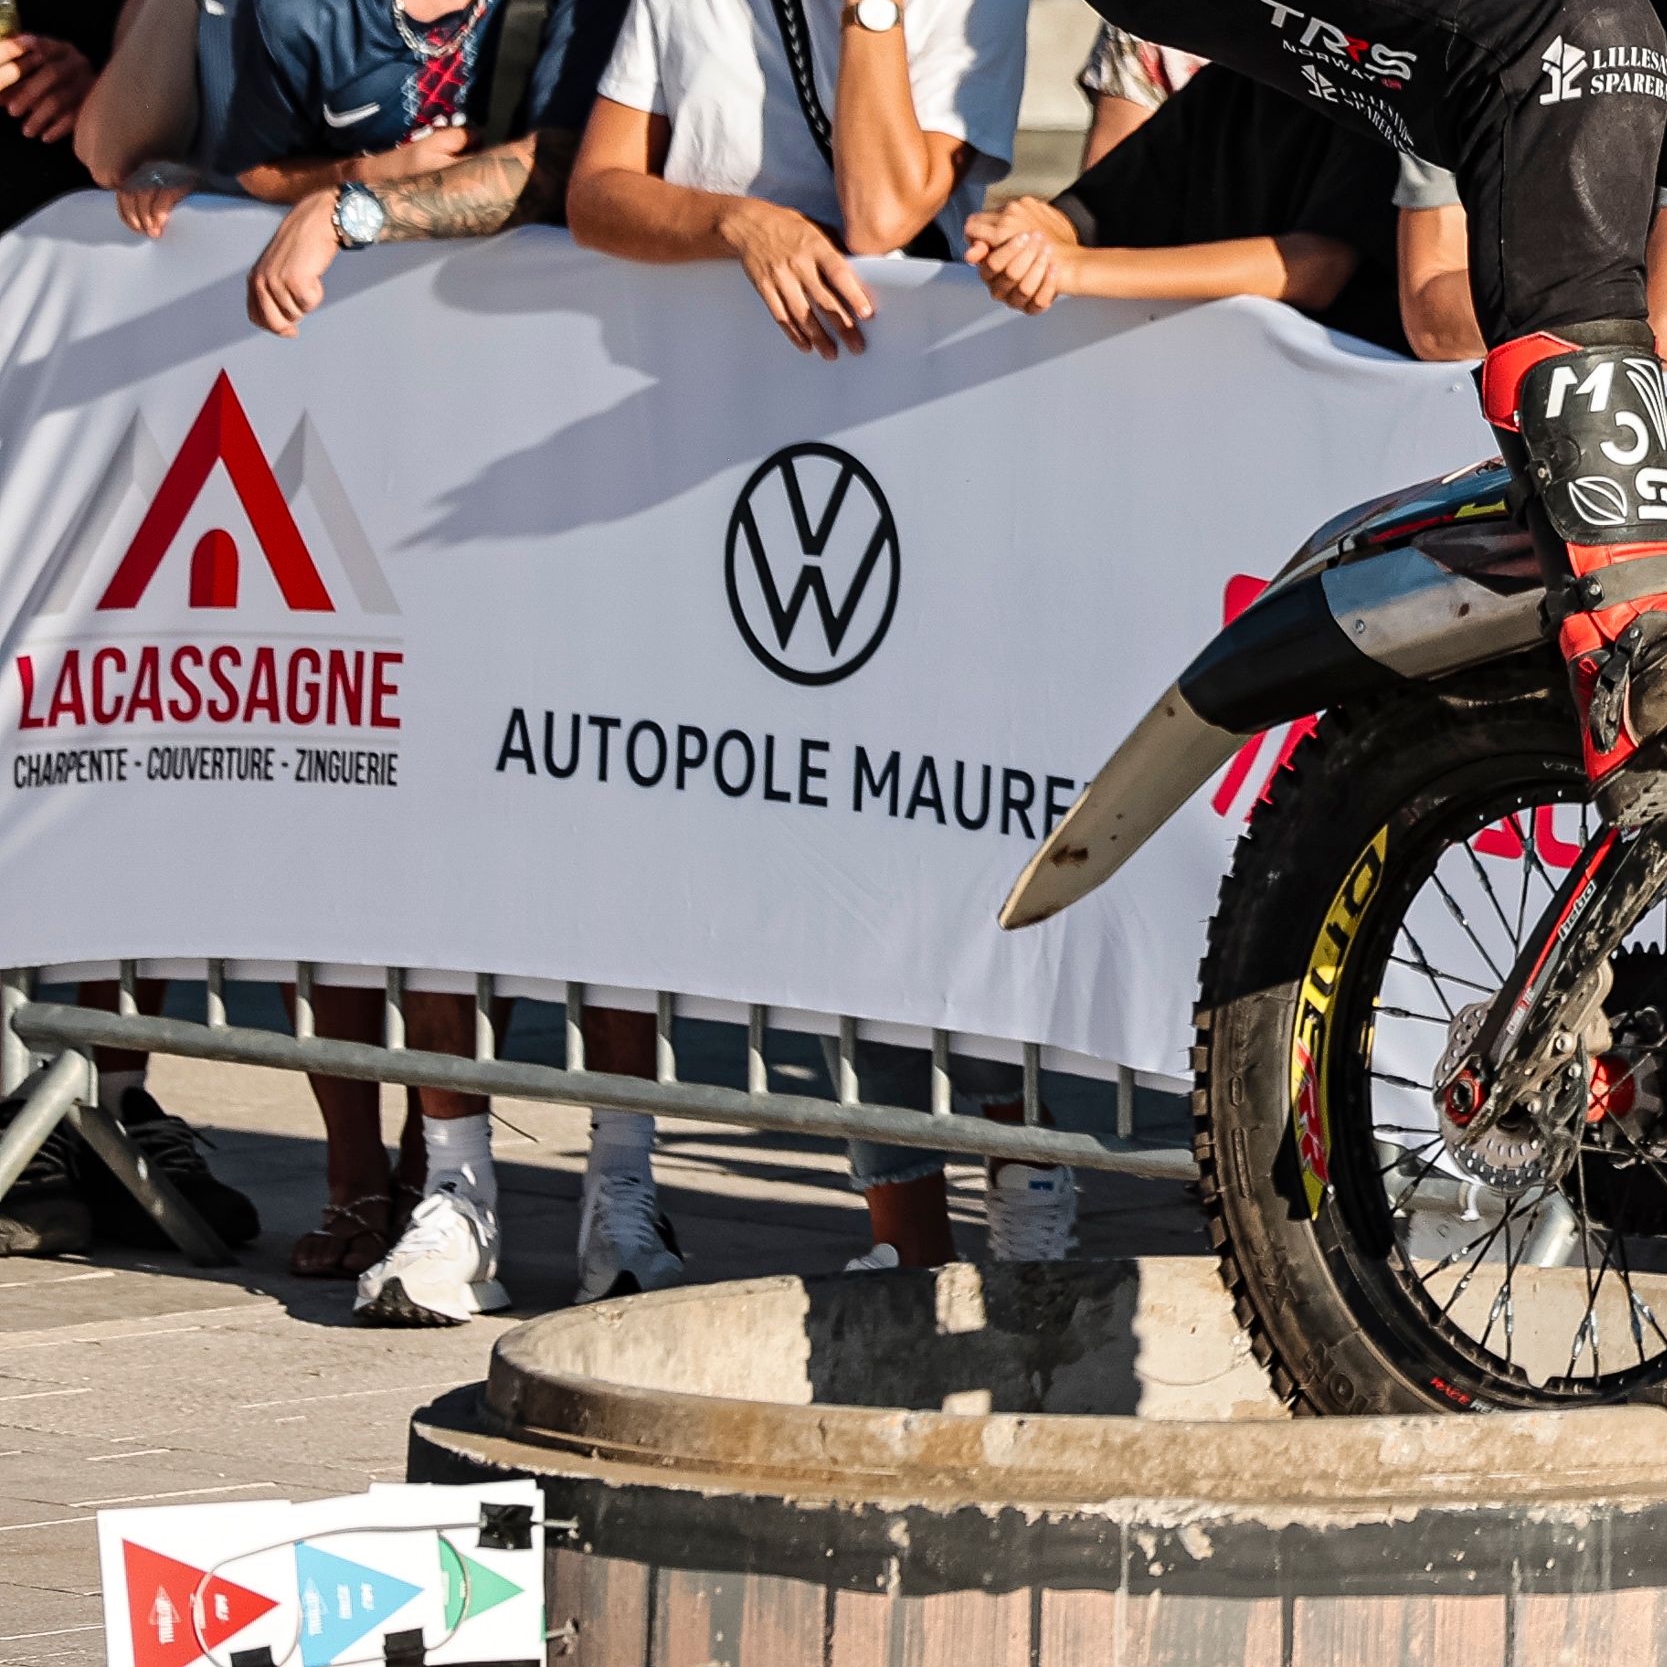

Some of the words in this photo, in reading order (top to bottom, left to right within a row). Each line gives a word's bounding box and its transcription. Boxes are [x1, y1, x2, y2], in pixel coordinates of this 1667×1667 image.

[1282, 39, 1376, 82] NORWAY
[16, 645, 403, 730] LACASSAGNE
[13, 747, 128, 789] CHARPENTE
[146, 745, 275, 782] COUVERTURE
[294, 750, 399, 788] ZINGUERIE
[496, 707, 830, 809] AUTOPOLE
[851, 745, 1078, 840] MAURE
[1558, 881, 1597, 942] hebo
